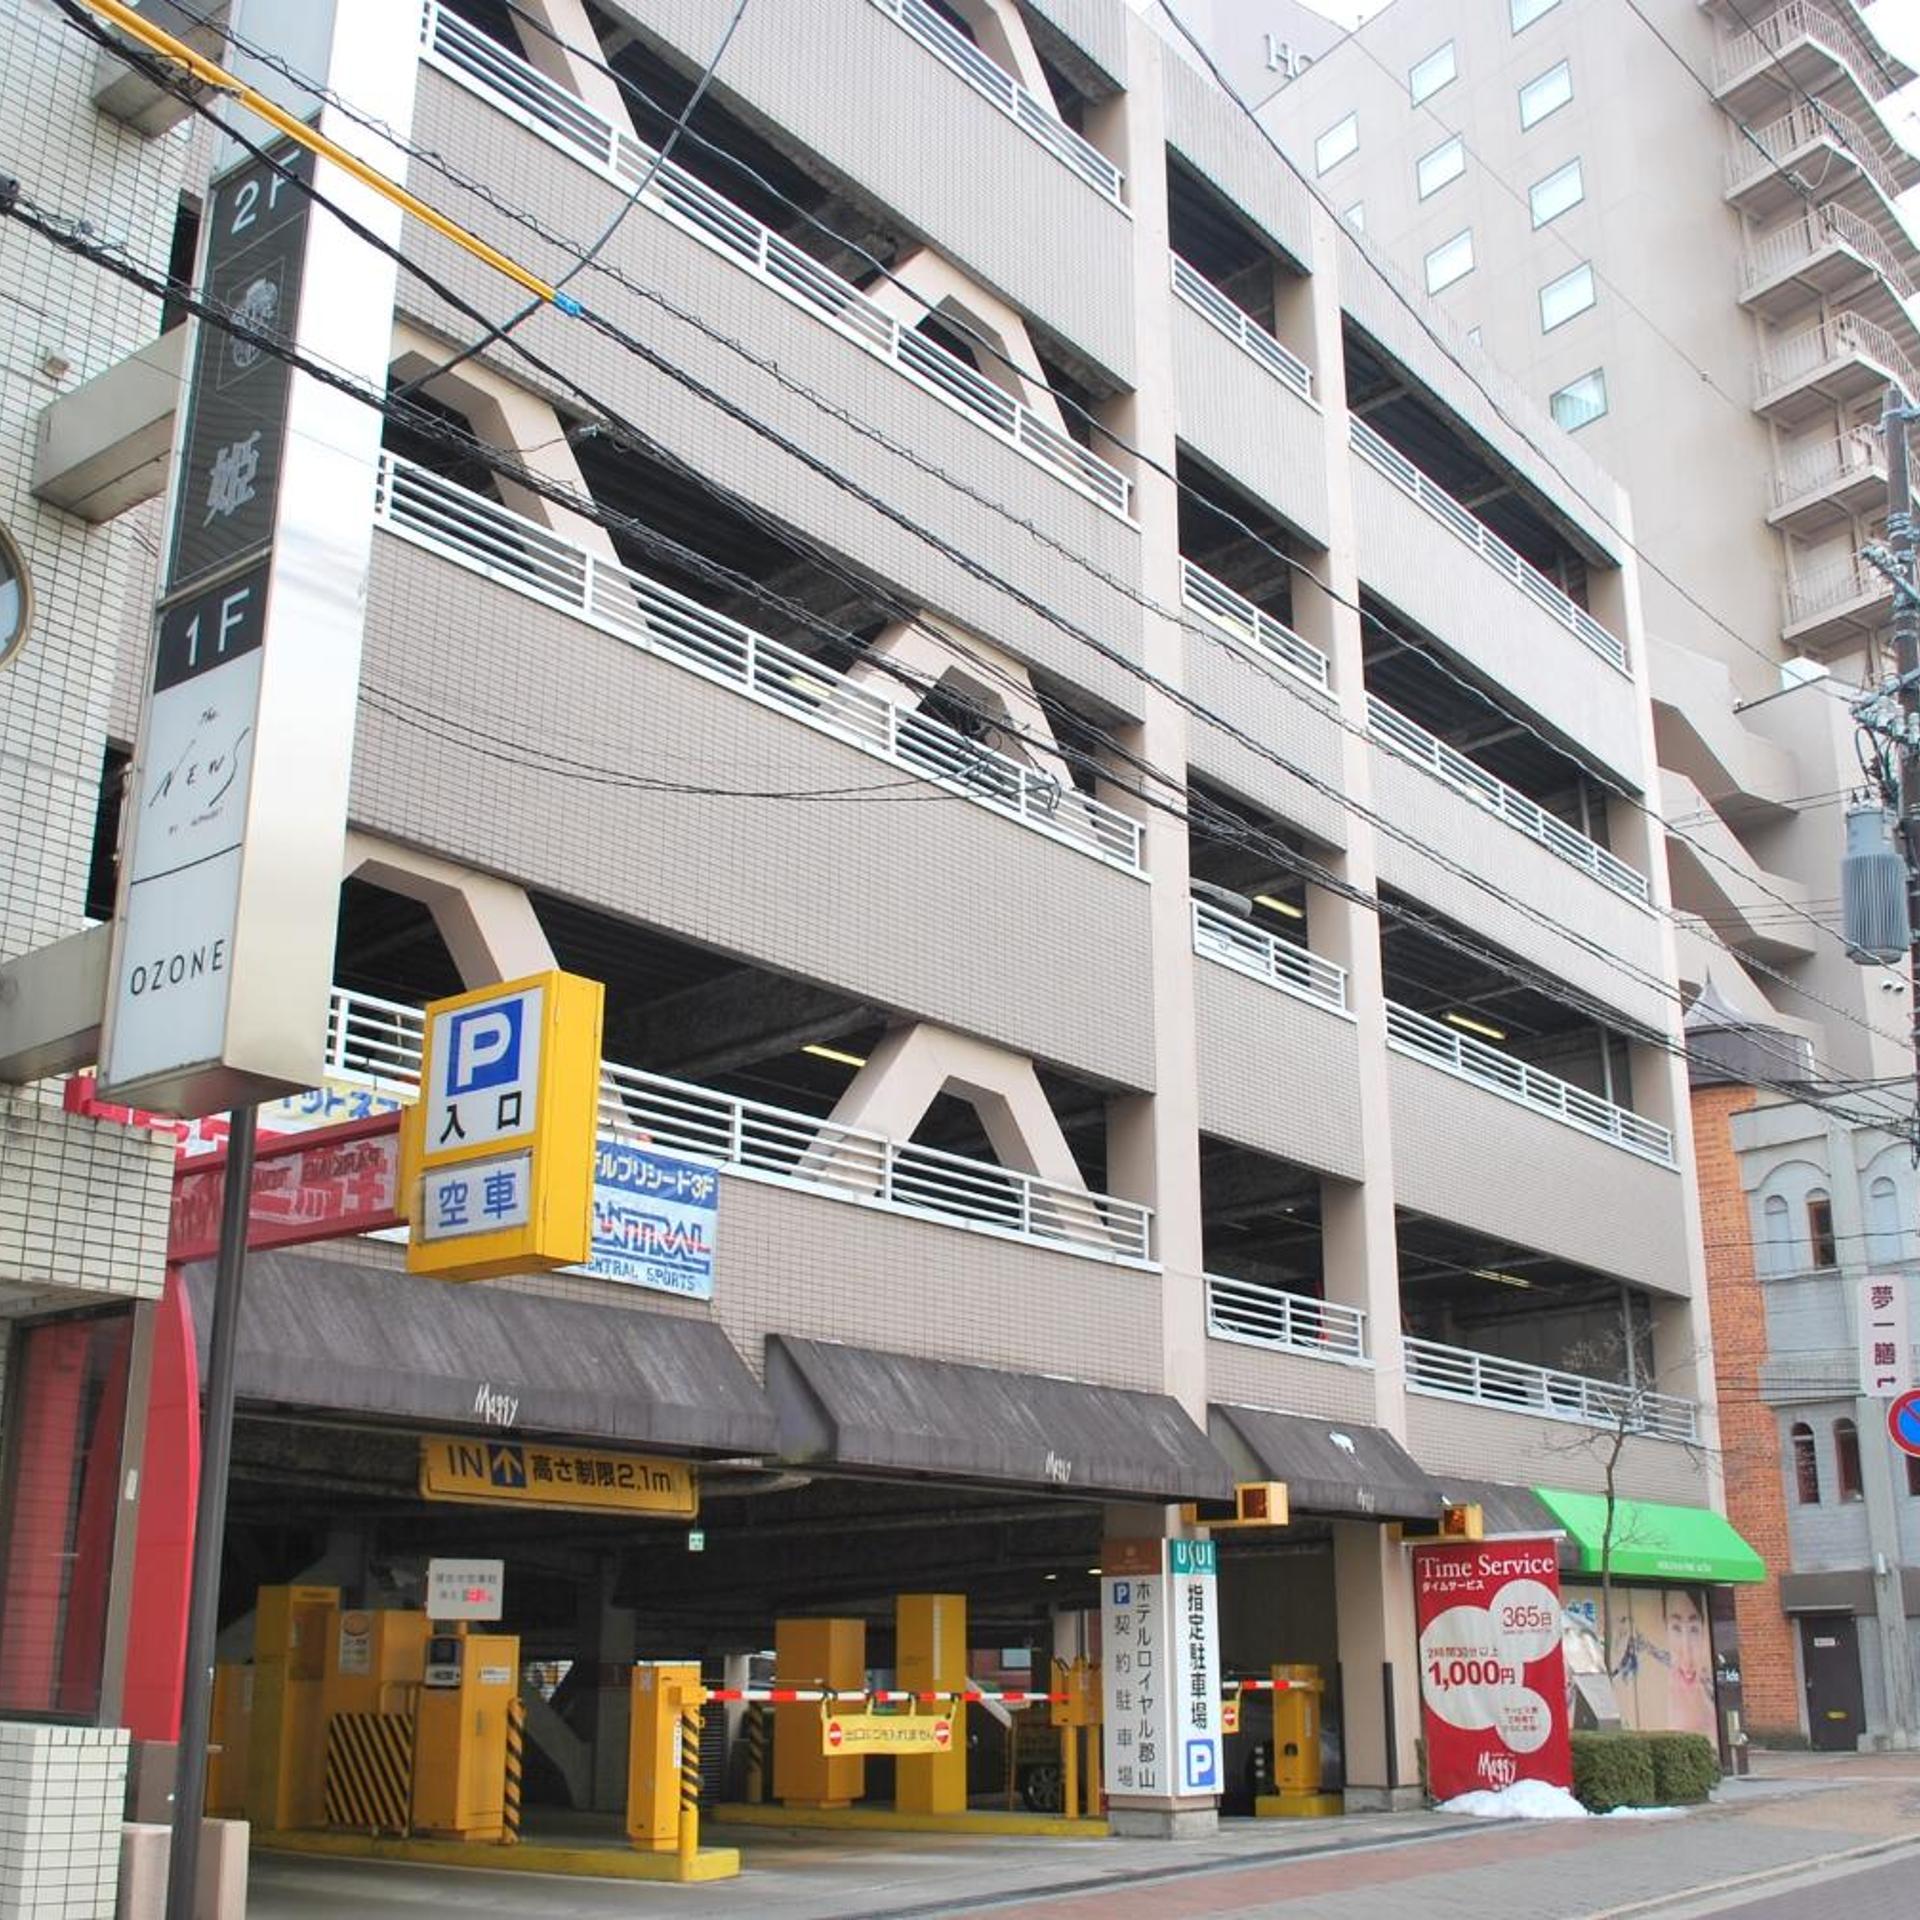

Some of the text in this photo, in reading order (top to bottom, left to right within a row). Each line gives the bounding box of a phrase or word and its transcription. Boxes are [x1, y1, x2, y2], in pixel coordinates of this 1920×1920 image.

[231, 149, 301, 234] 2F
[185, 587, 250, 667] 1F
[131, 939, 225, 996] OZONE
[457, 1011, 512, 1088] P
[440, 1091, 522, 1144] 入口
[438, 1169, 518, 1228] 空車
[646, 1265, 696, 1292] SPORTS
[447, 1445, 671, 1492] IN 高さ制限2.1m
[1419, 1552, 1554, 1578] Time Service
[1502, 1605, 1552, 1628] 365日
[1136, 1580, 1155, 1788] ホテルロイヤル郡山
[1188, 1583, 1207, 1730] 指定駐車場
[1428, 1659, 1516, 1691] 1,000円
